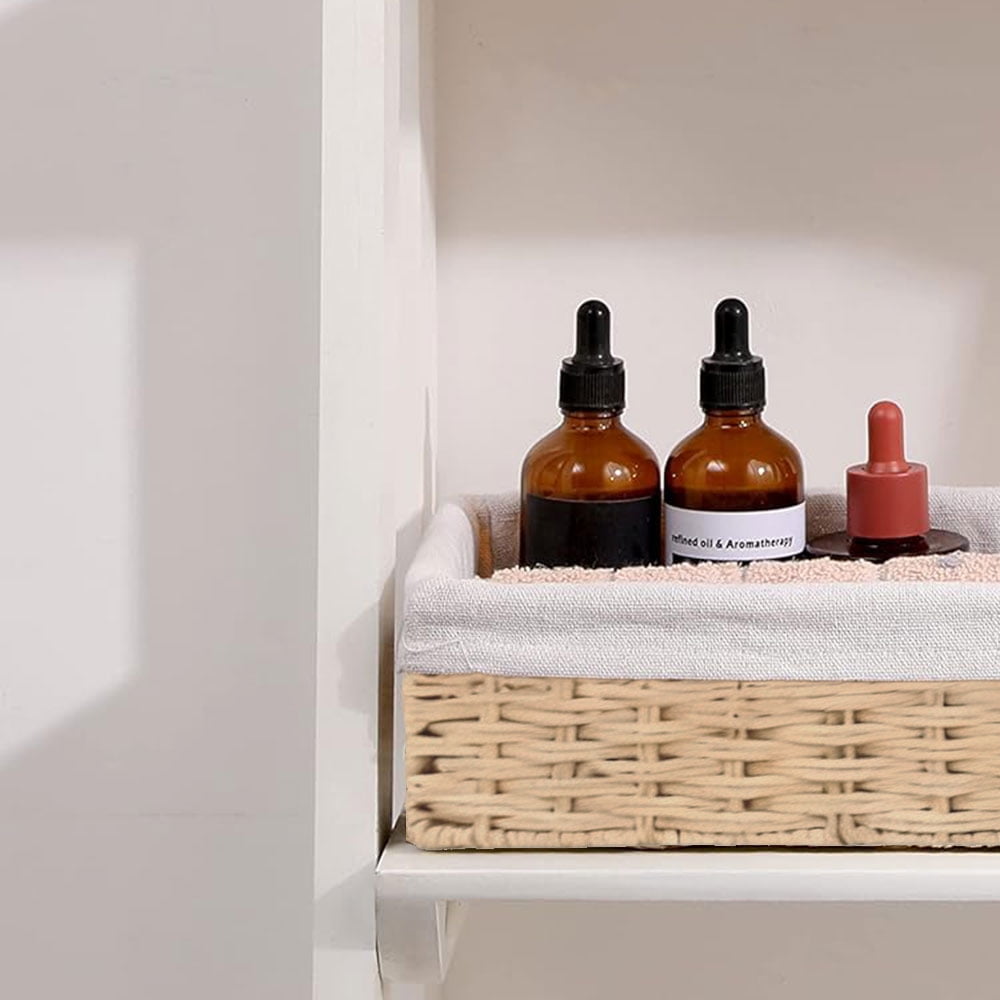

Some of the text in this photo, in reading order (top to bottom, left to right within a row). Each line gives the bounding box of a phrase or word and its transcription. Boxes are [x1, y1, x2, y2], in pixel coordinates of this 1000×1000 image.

[671, 534, 794, 549] refined oil & Aromatherapy
